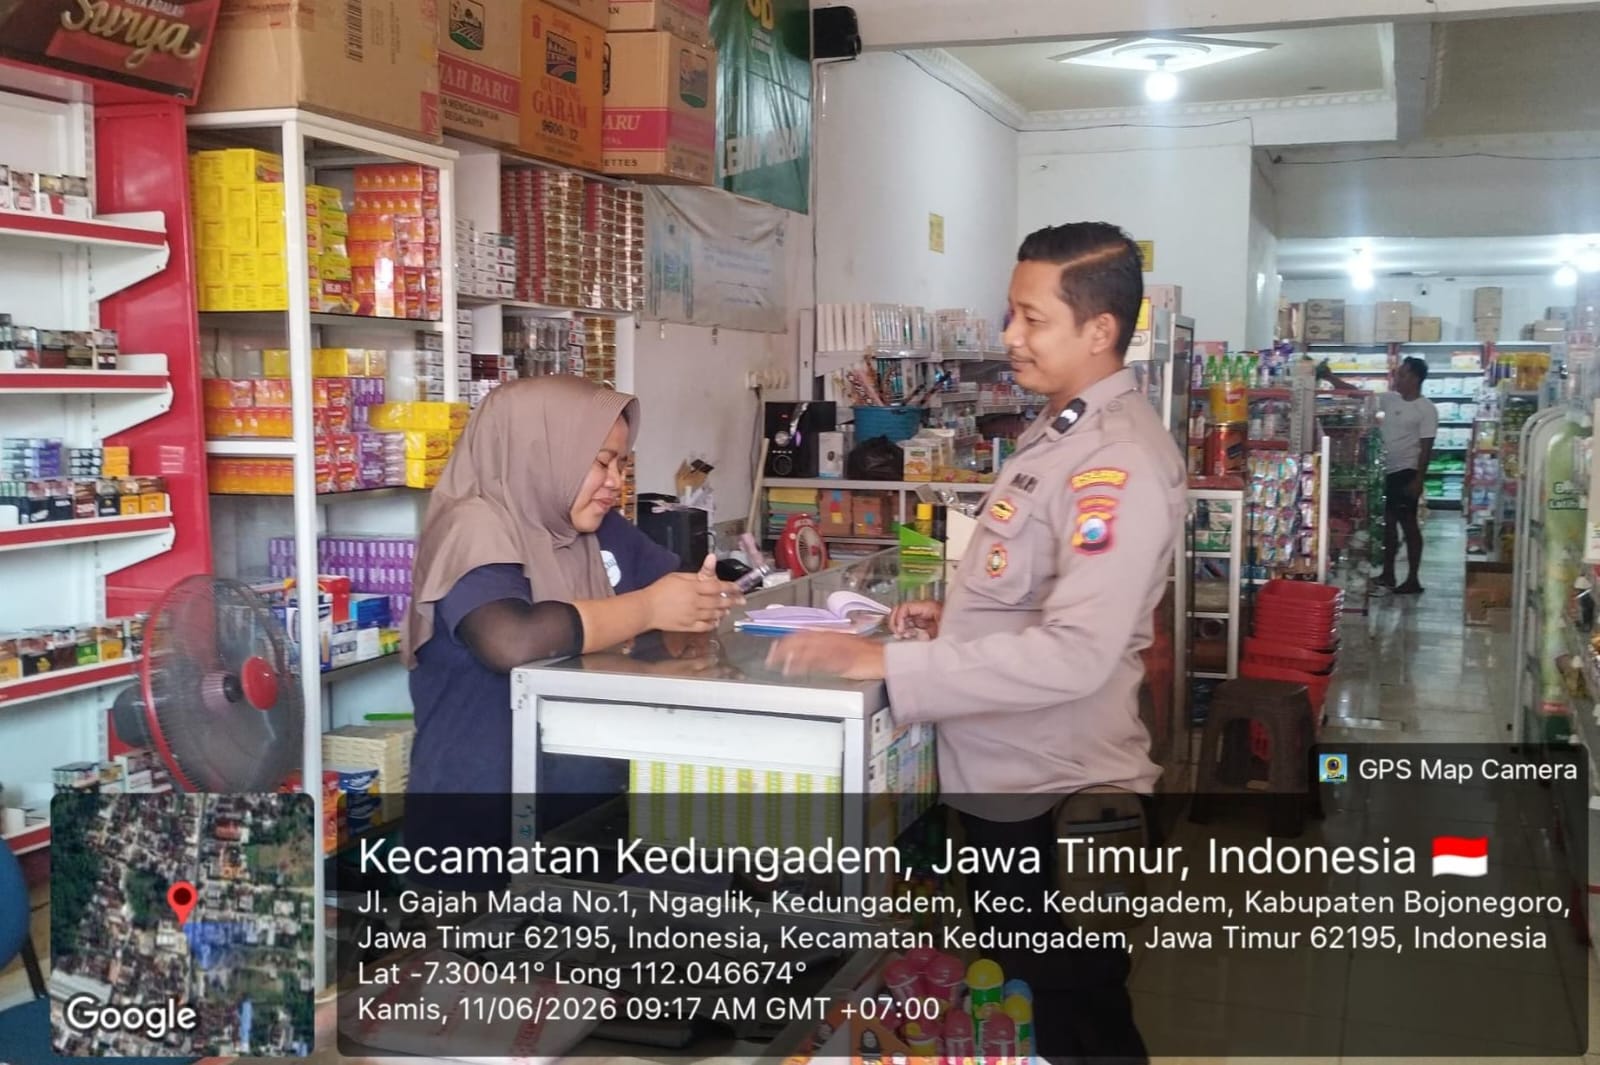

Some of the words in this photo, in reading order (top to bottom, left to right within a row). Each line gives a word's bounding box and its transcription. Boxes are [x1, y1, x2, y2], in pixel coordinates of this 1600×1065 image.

[61, 0, 201, 68] Surya
[471, 73, 515, 103] BARU
[532, 90, 588, 128] GARAM
[602, 114, 641, 131] ARU
[603, 158, 638, 167] ETTES
